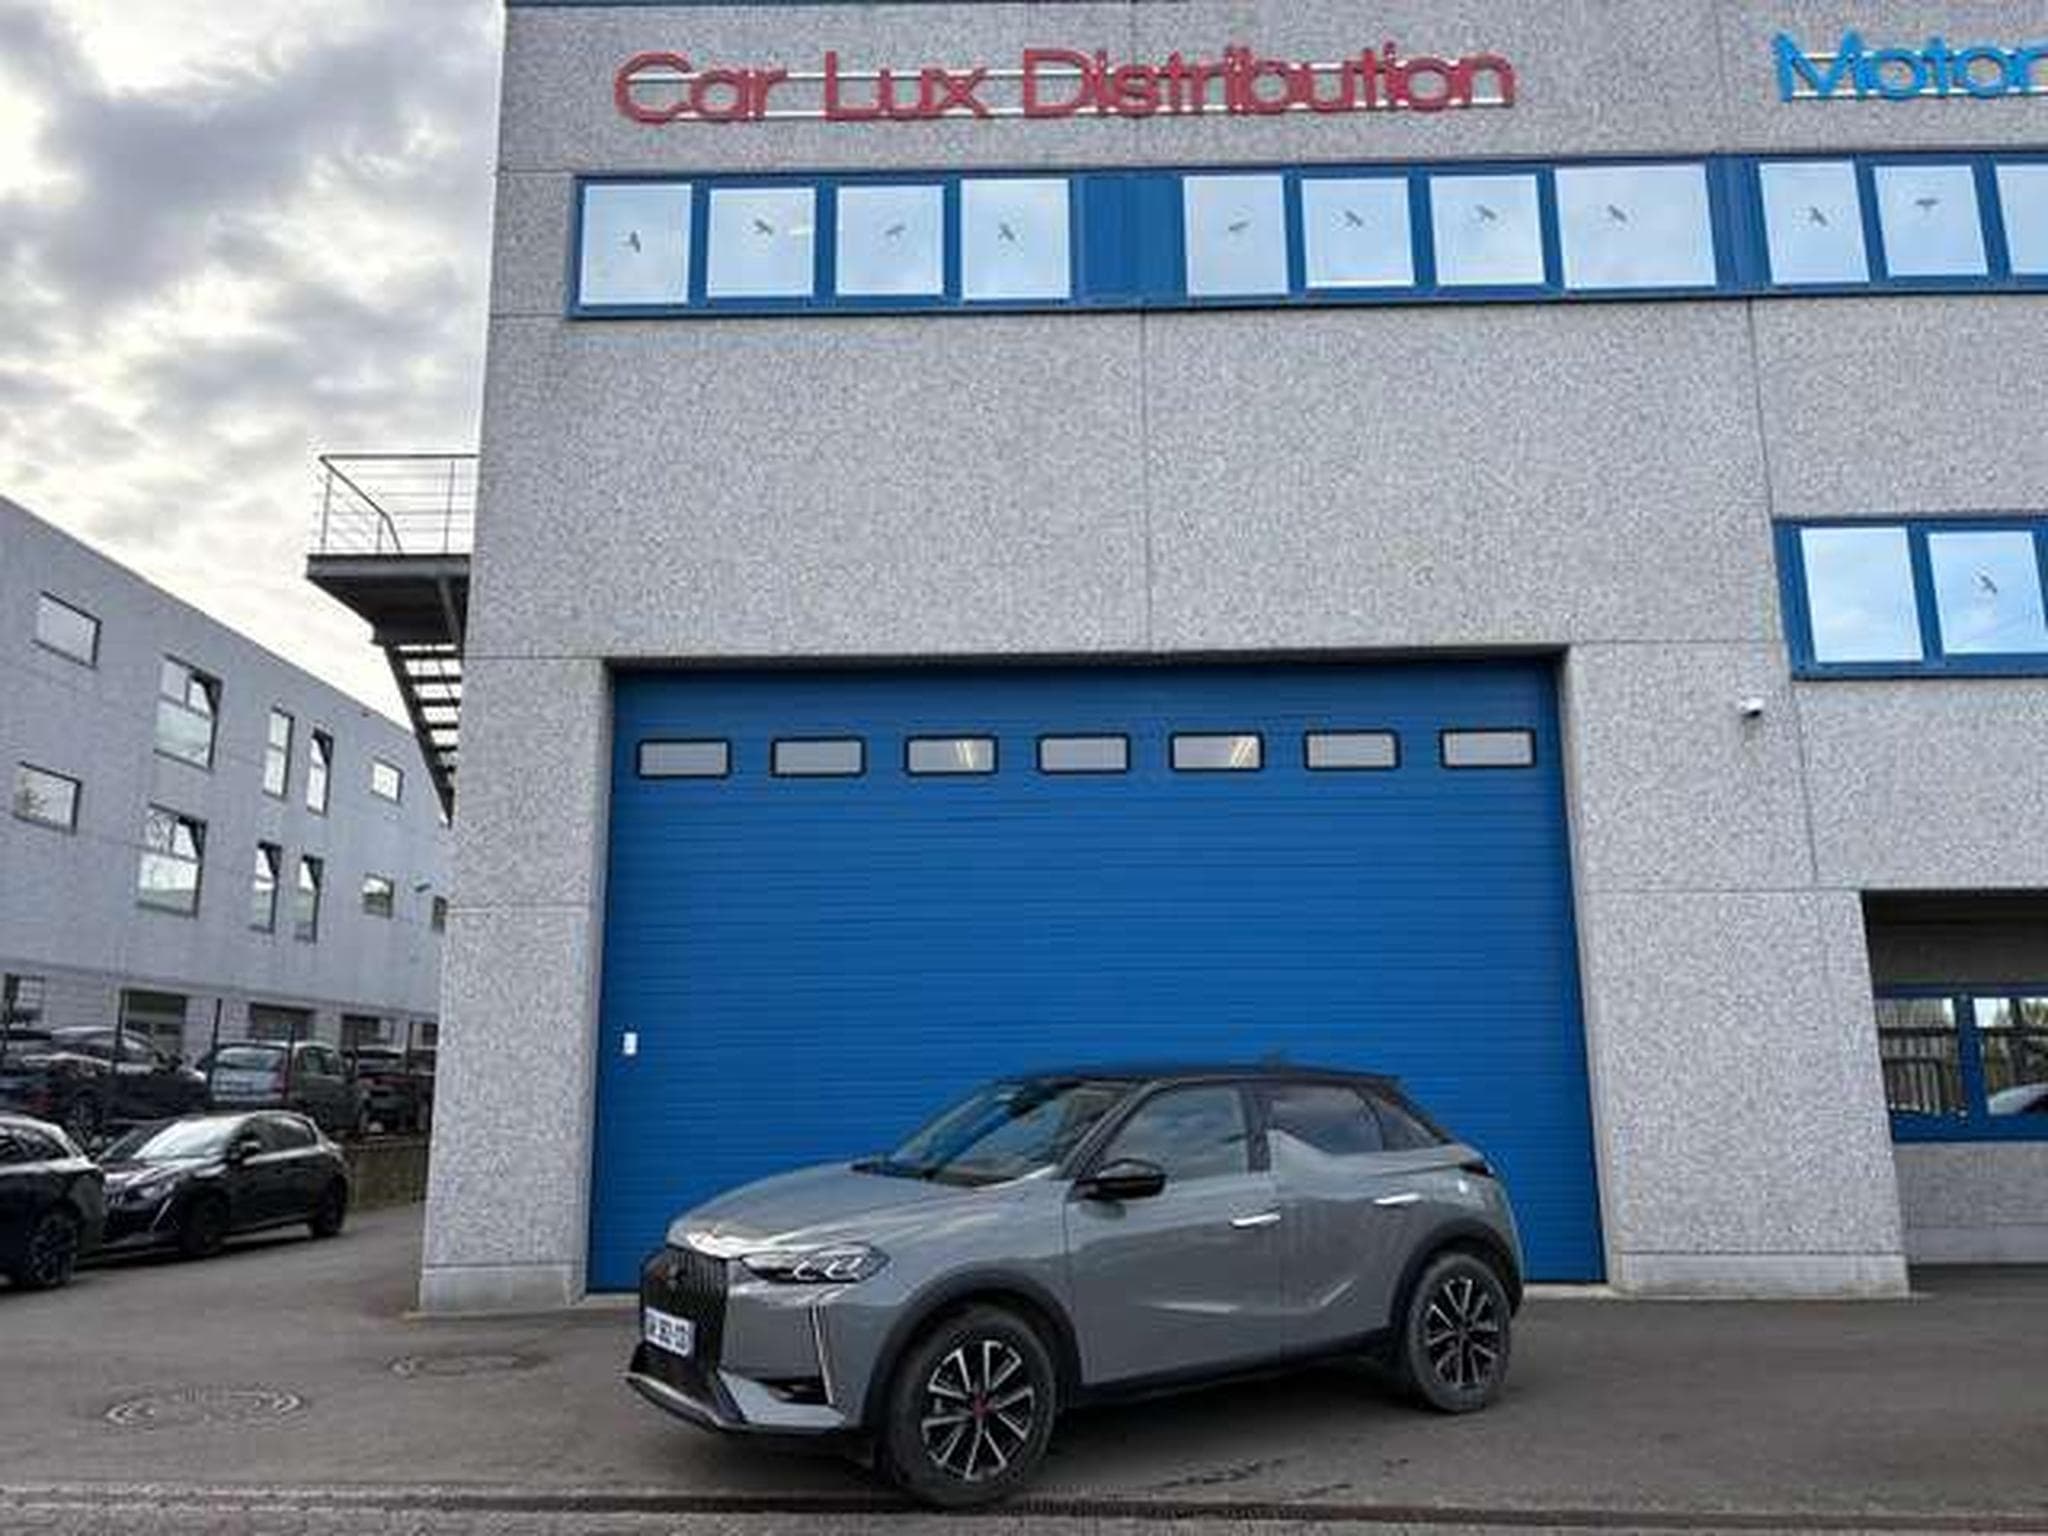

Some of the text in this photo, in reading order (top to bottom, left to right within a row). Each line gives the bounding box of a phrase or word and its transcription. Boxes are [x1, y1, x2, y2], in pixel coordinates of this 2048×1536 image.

[614, 42, 1517, 123] Car Lux Distribution
